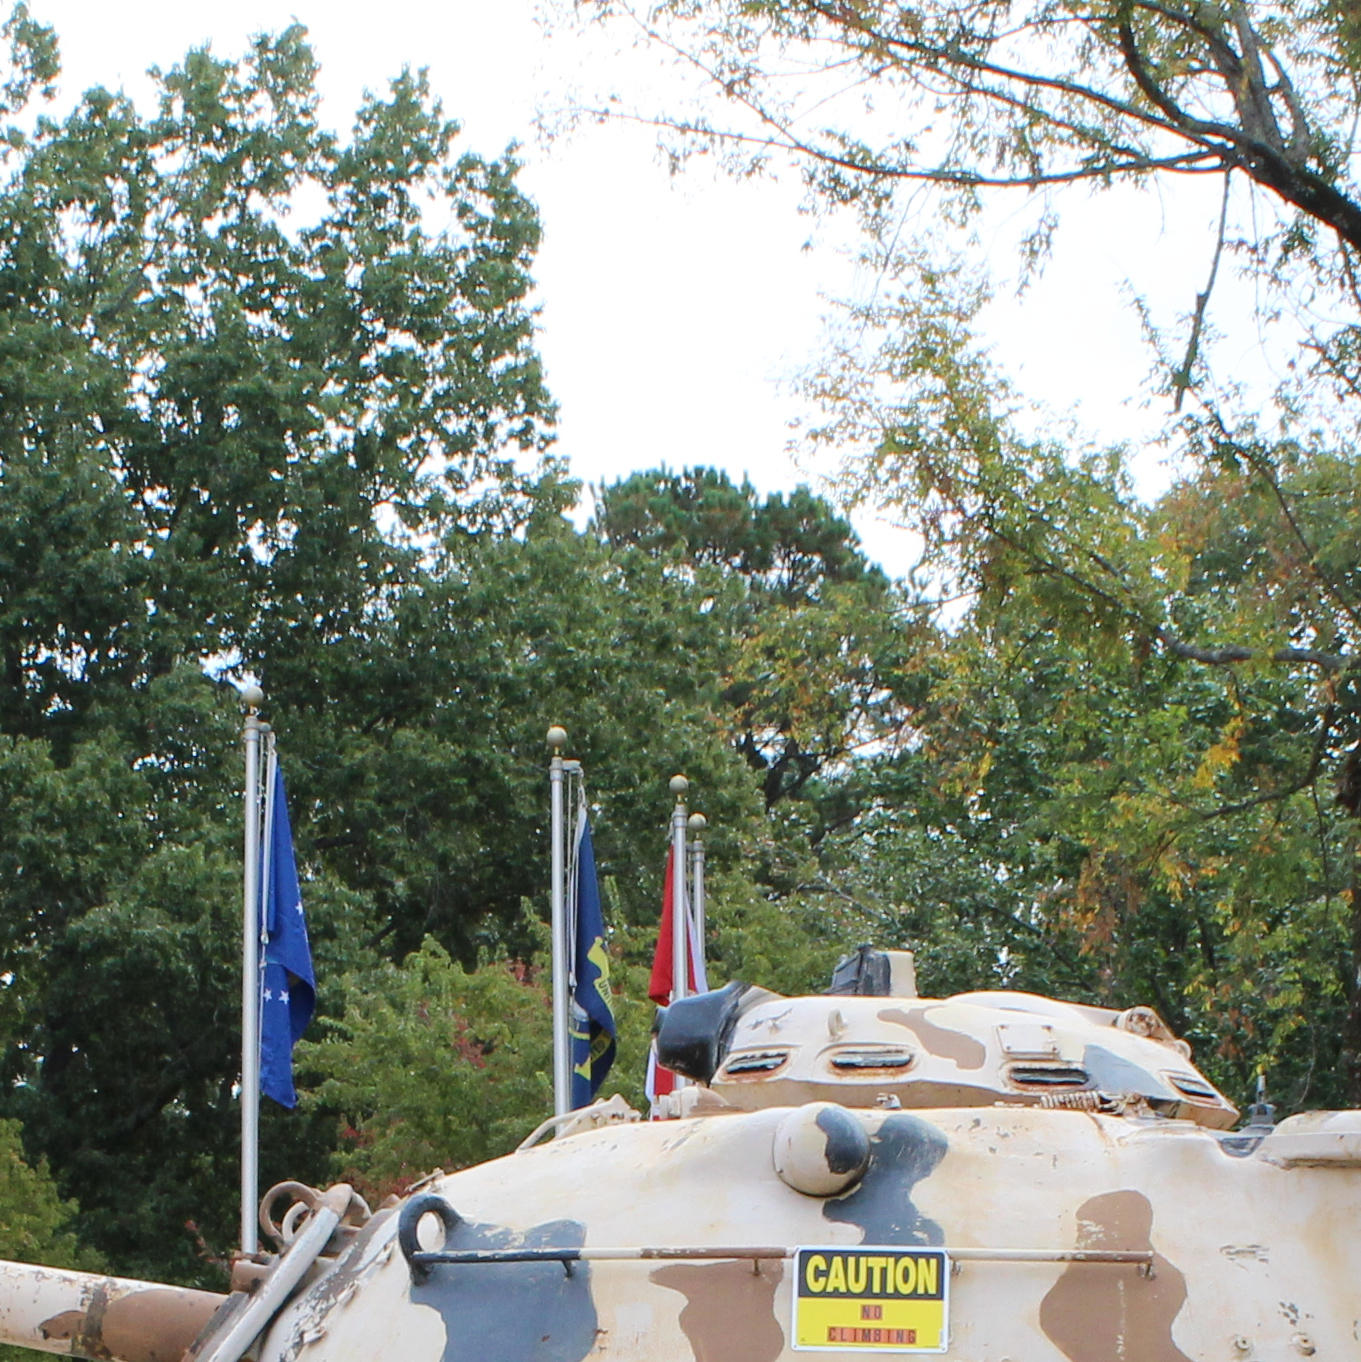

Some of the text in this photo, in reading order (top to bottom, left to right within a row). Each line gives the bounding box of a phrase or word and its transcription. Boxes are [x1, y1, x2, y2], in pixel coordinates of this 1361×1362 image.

[806, 1254, 938, 1295] CAUTION
[862, 1305, 882, 1319] NO
[828, 1327, 916, 1343] CLIMBING
